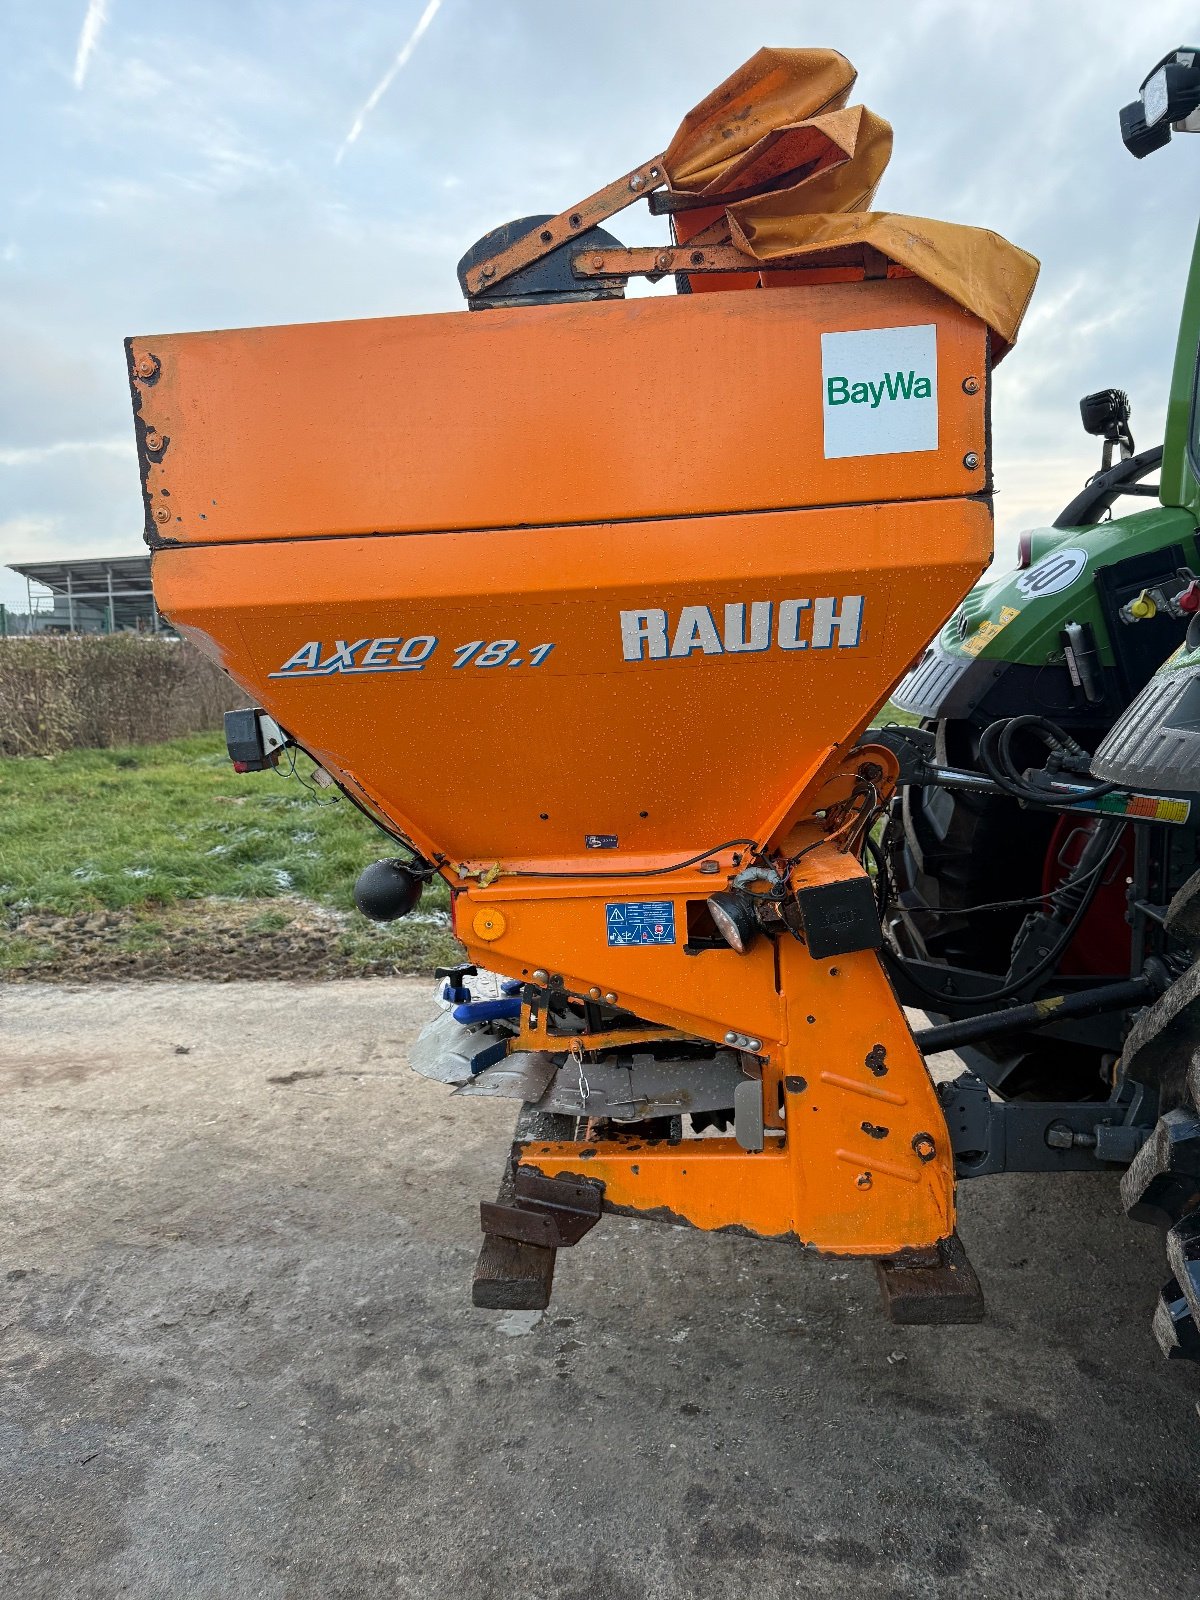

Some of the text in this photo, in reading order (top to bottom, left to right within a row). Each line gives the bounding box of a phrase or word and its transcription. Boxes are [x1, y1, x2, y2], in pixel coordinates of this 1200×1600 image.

[827, 370, 932, 409] BayWa
[1023, 554, 1077, 592] 40
[619, 595, 865, 662] RAUCH
[279, 636, 555, 671] AXEO 18.1
